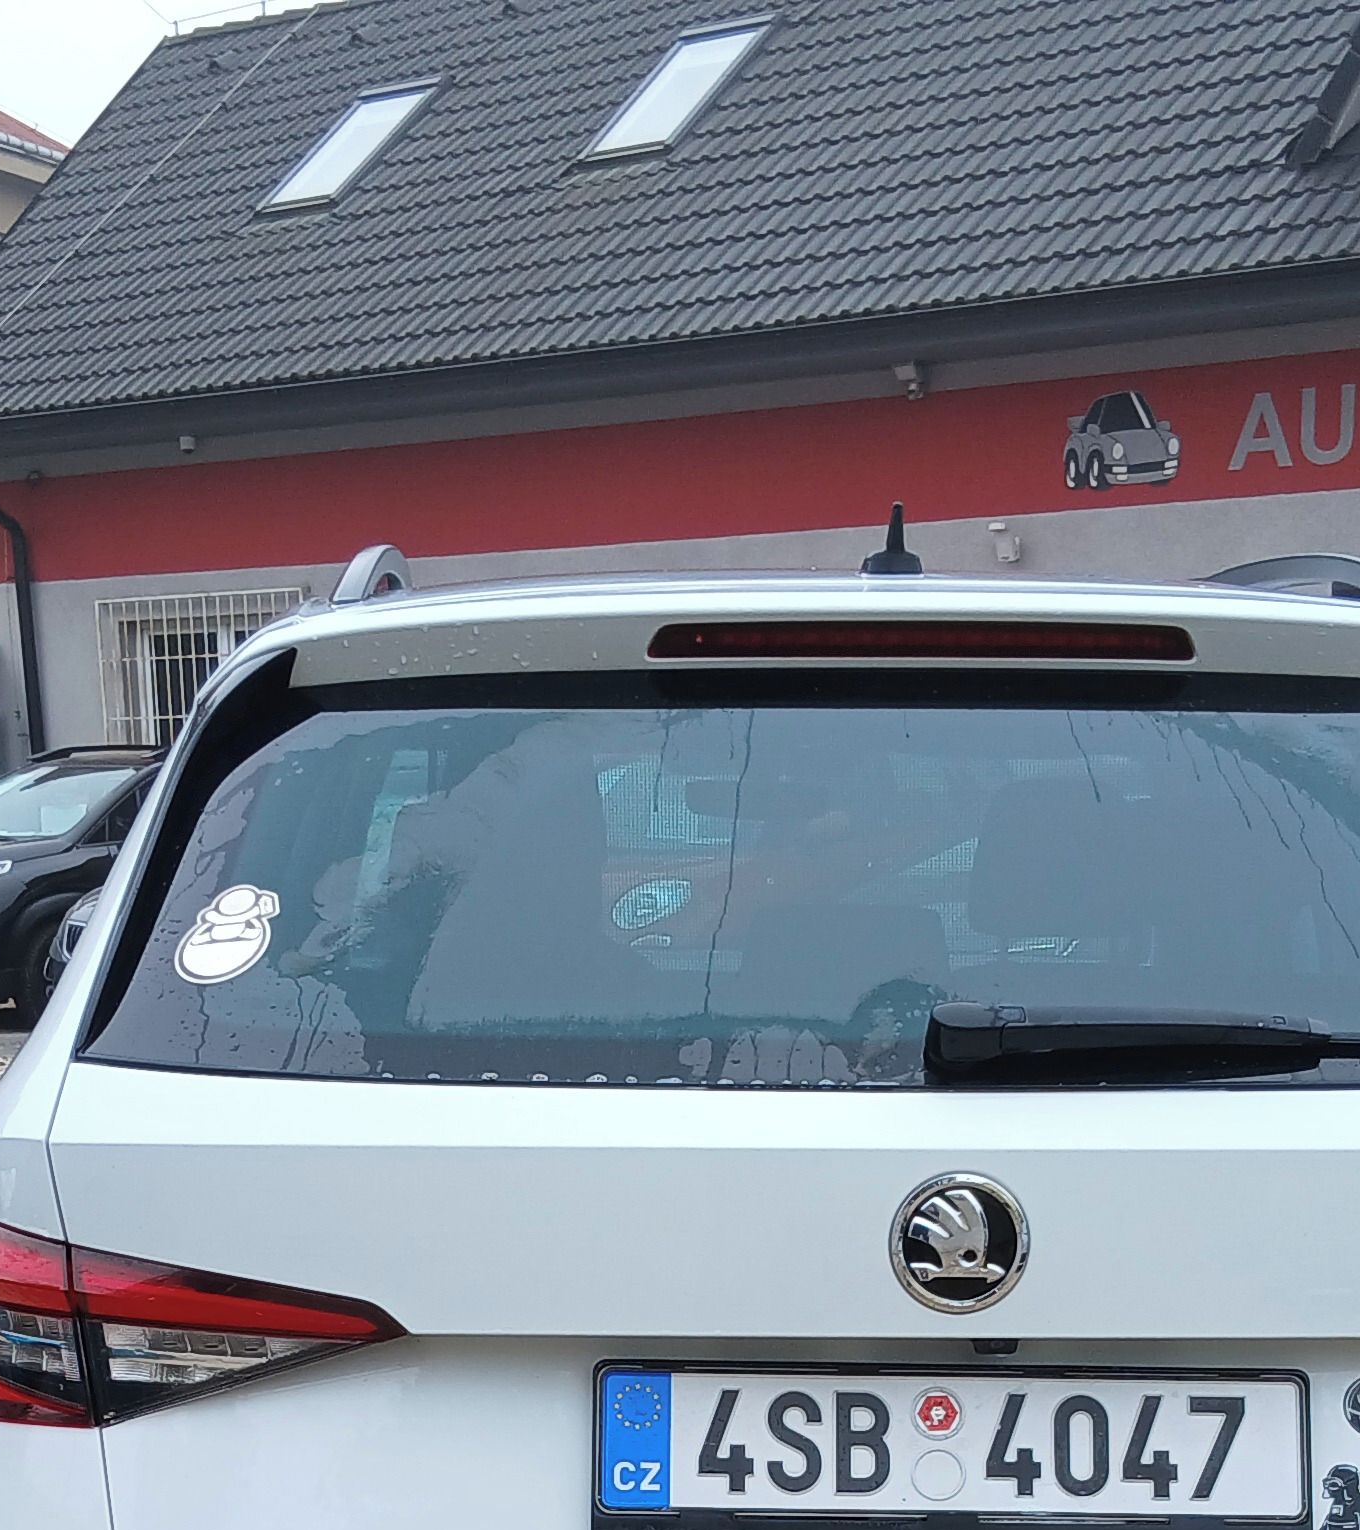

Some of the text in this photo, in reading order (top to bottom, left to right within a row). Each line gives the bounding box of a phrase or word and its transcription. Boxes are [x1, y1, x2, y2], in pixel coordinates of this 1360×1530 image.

[613, 1462, 662, 1492] CZ
[696, 1388, 1247, 1500] 4SB 4047
